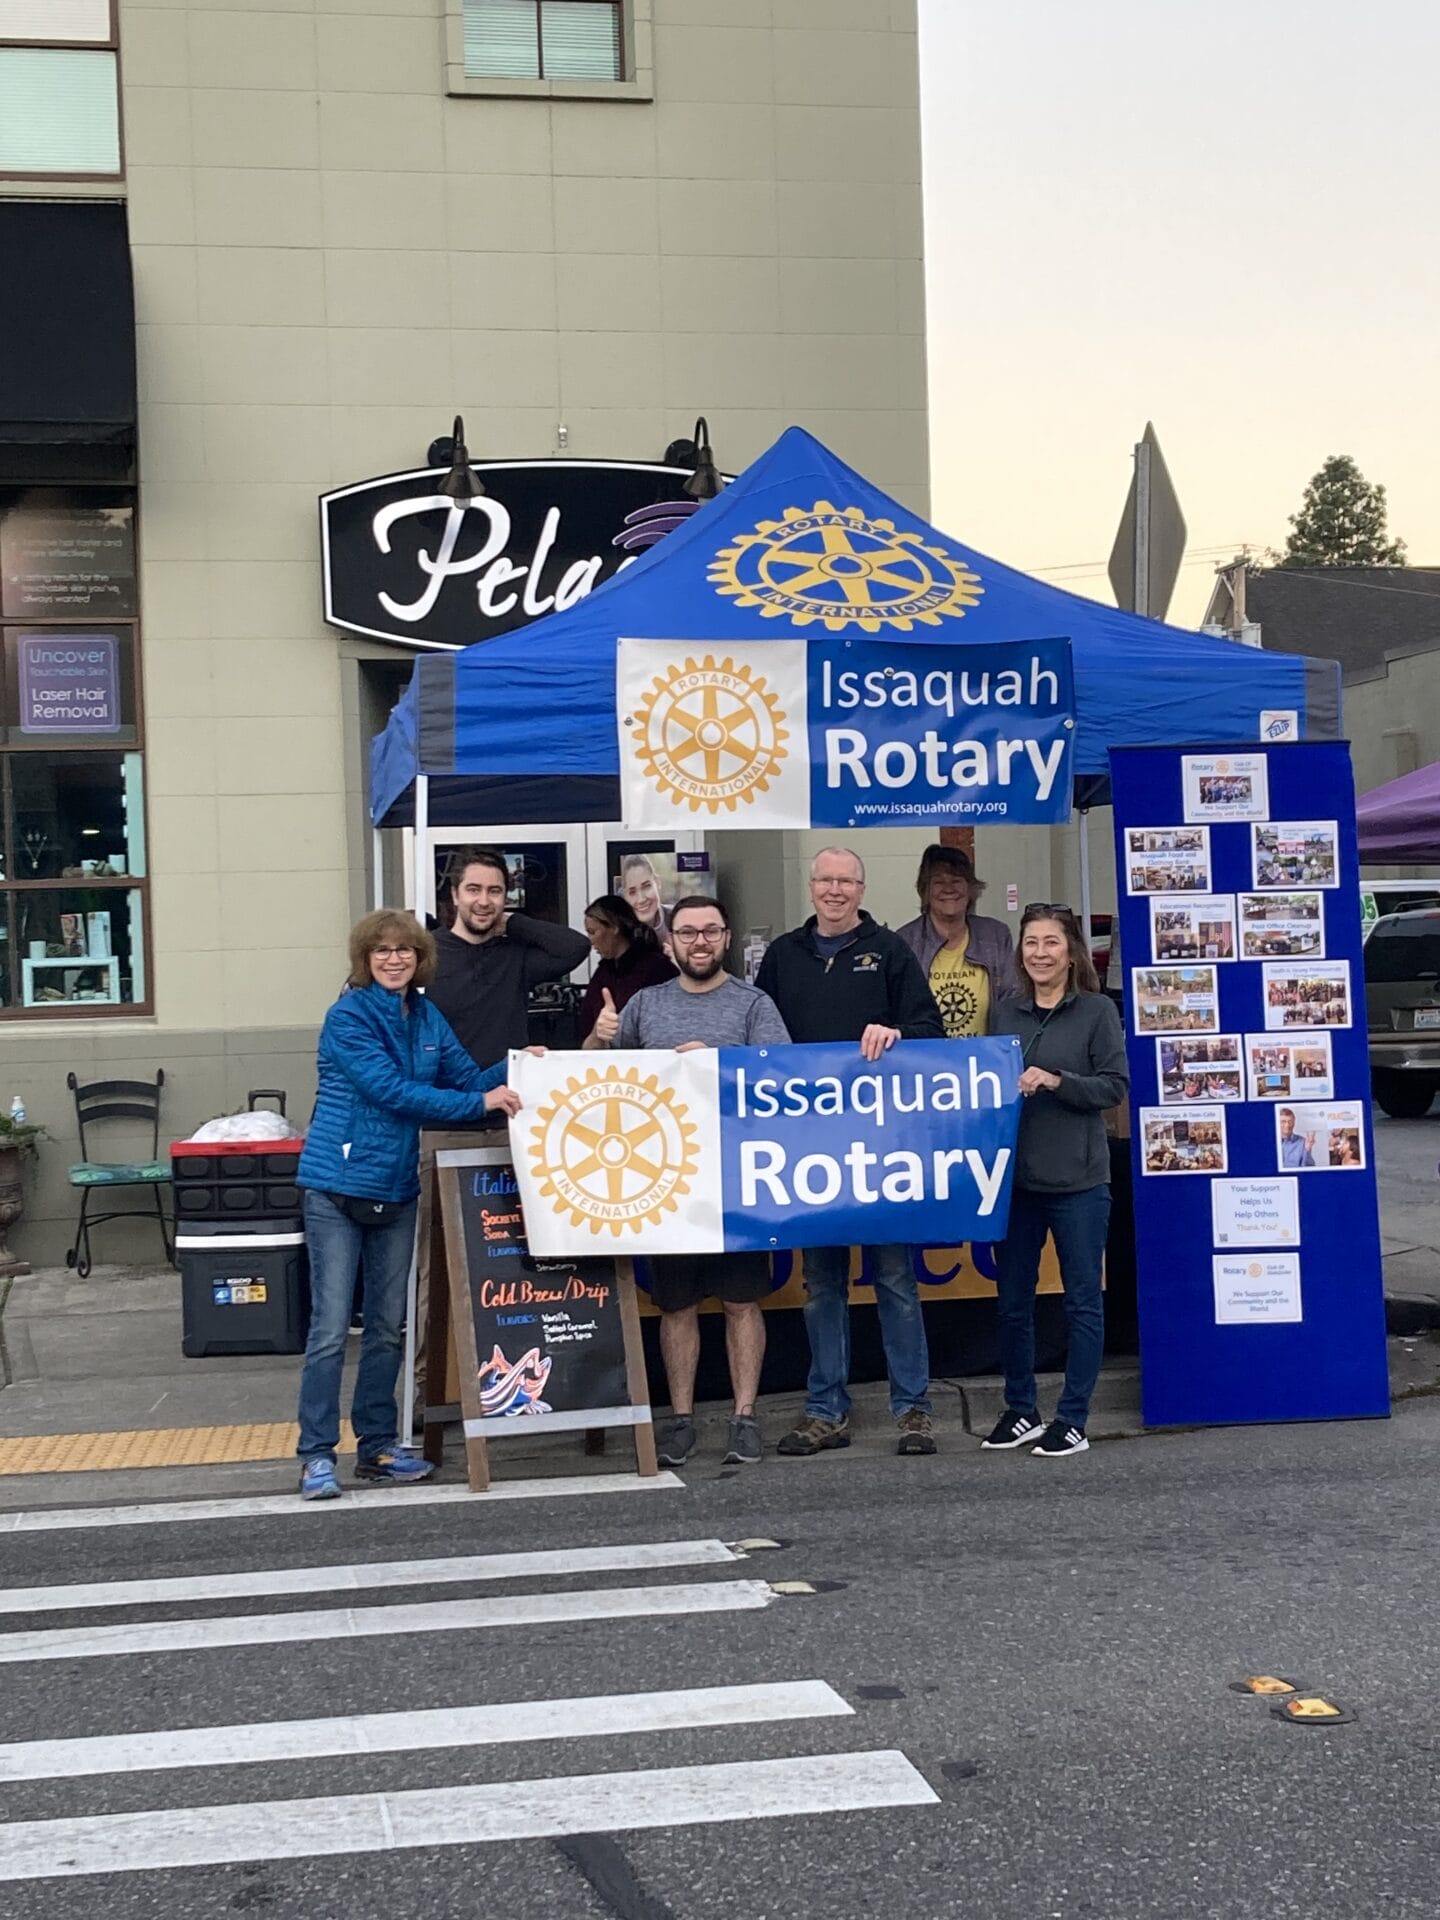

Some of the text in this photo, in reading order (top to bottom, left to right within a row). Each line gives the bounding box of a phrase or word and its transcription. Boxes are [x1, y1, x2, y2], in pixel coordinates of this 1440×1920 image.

[775, 515, 883, 538] ROTARY
[372, 494, 640, 622] Pela
[761, 589, 951, 618] INTERNATIONAL
[31, 648, 106, 663] Uncover
[678, 673, 741, 691] ROTARY
[823, 656, 1058, 717] Issaquah
[32, 687, 106, 701] Laser Hair
[32, 703, 108, 718] Removal
[825, 729, 1065, 801] Rotary
[658, 759, 767, 796] INTERNATIONAL
[854, 801, 1007, 816] www.issaquahrotary.org
[930, 969, 976, 981] OTARIAN
[576, 1084, 648, 1105] ROTARY
[736, 1056, 1003, 1127] Issaquah
[740, 1140, 1011, 1216] Rotary
[1250, 1184, 1280, 1193] Support
[557, 1176, 674, 1218] INTERNATIONAL
[1240, 1198, 1261, 1207] Helps
[1234, 1210, 1279, 1219] Help Others
[481, 1279, 518, 1308] Cold
[541, 1311, 570, 1322] Vanilla
